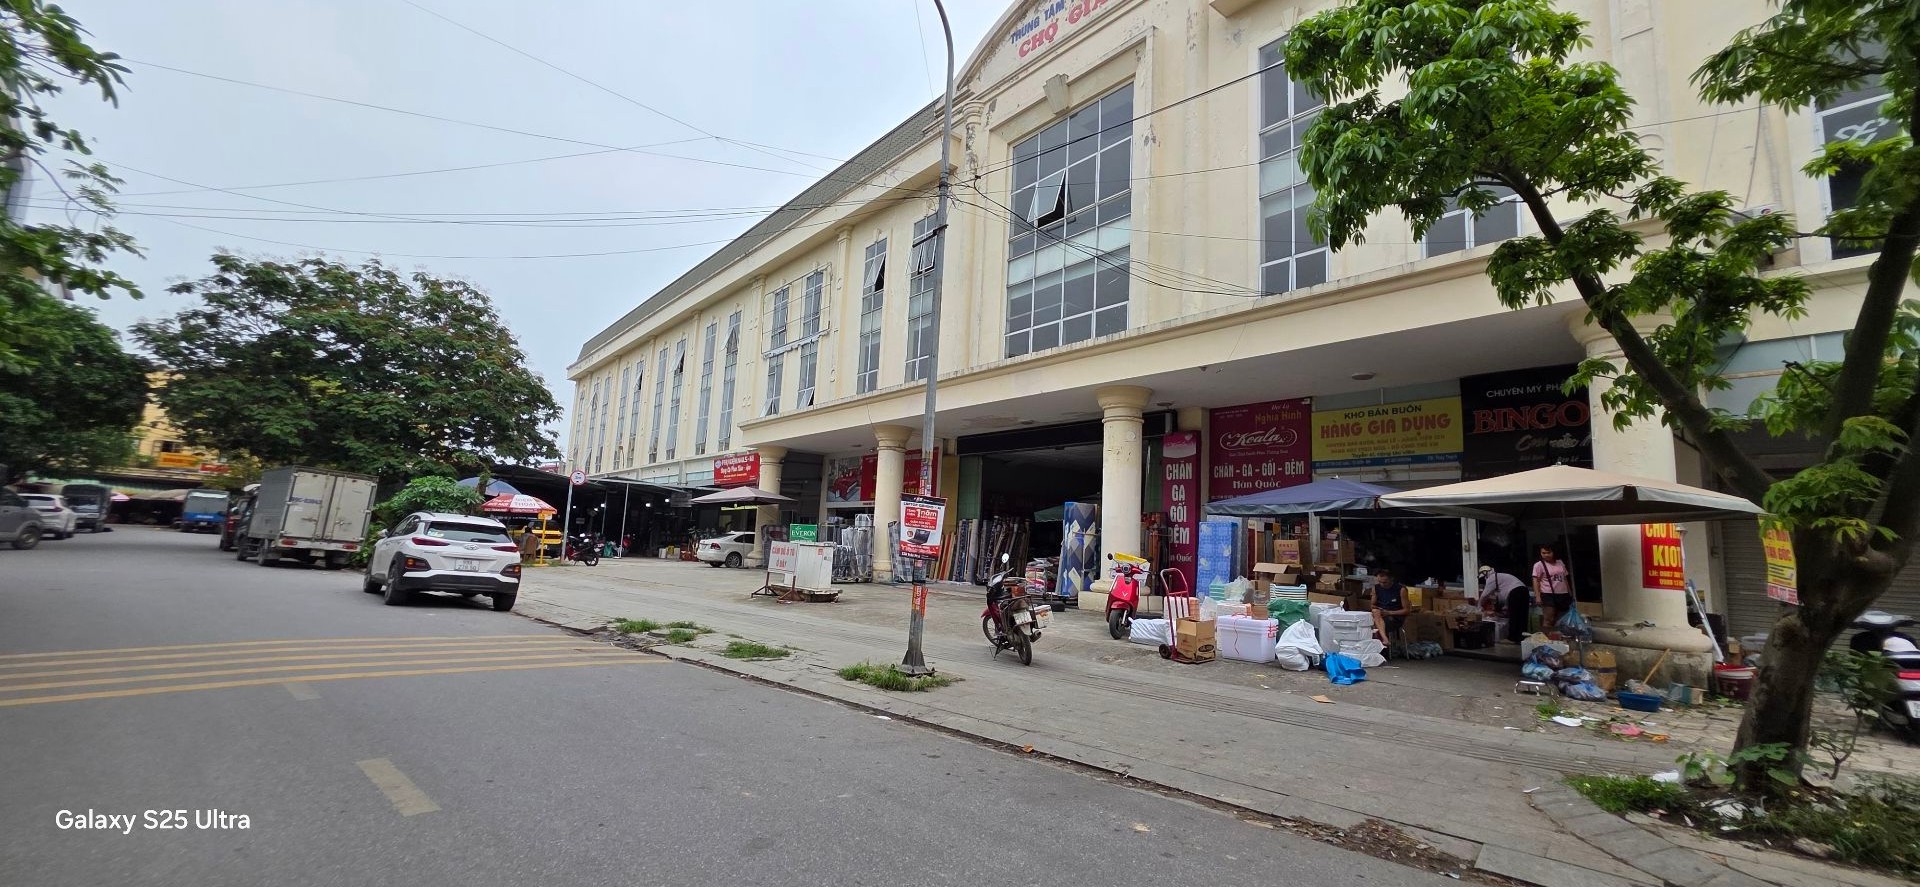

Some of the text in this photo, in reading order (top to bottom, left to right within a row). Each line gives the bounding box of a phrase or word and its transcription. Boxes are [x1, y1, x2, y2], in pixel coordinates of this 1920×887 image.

[1010, 16, 1040, 44] TRUNG
[1018, 18, 1059, 57] CHỢ
[1344, 404, 1422, 419] KHO BÁN BUÔN
[1472, 400, 1590, 434] BINGO
[1320, 413, 1451, 438] HÀNG GIA DỤNG
[1166, 460, 1193, 480] CHĂN
[1213, 463, 1234, 478] CHĂN
[1242, 463, 1253, 477] GA
[1261, 459, 1276, 476] GỐI
[1284, 459, 1305, 478] ĐỆM
[1171, 484, 1186, 502] GA
[920, 509, 937, 517] năm
[1170, 502, 1187, 523] GỐI
[791, 529, 816, 537] EVERON
